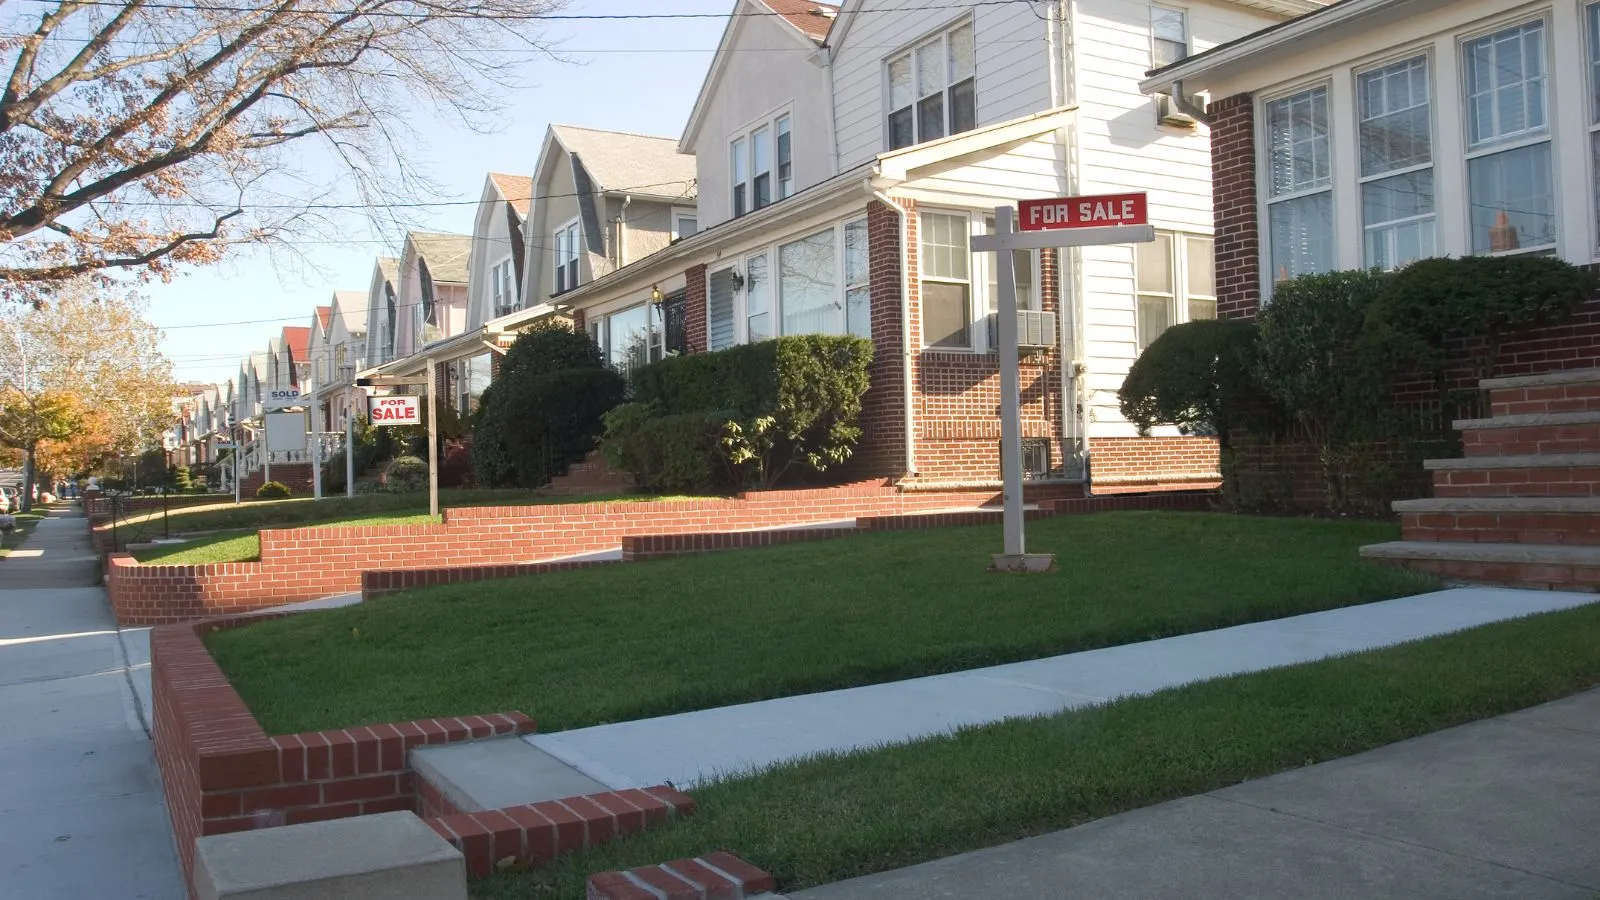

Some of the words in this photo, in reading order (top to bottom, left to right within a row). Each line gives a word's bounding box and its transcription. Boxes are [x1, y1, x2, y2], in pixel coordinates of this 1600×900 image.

[1029, 204, 1069, 225] FOR
[1079, 200, 1135, 222] SALE
[271, 390, 299, 398] SOLD
[372, 407, 416, 420] SALE
